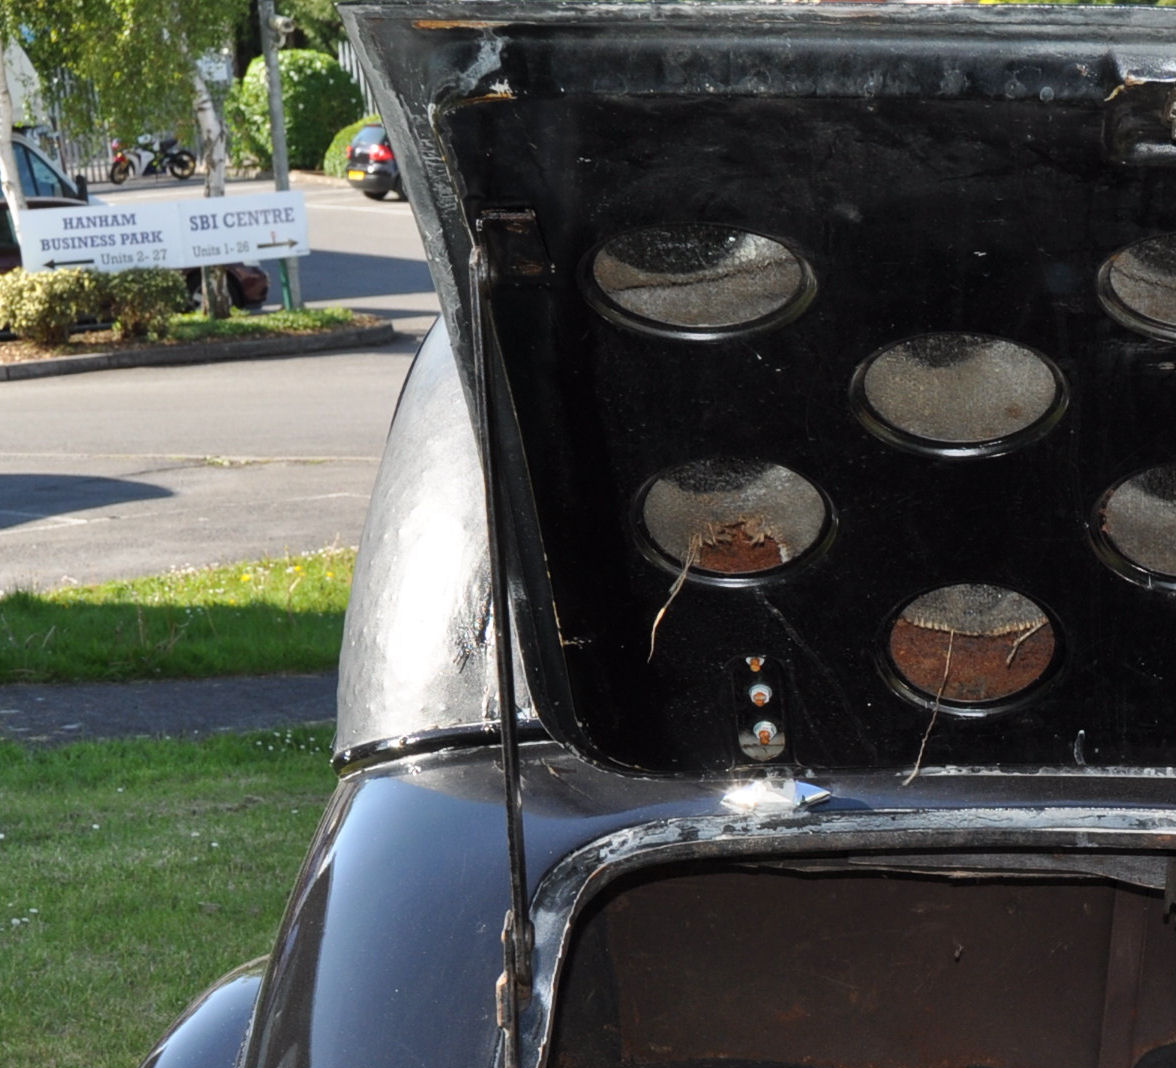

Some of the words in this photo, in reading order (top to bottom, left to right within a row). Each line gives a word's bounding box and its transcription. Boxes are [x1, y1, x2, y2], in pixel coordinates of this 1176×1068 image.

[62, 213, 137, 230] HANHAM
[189, 213, 218, 231] SBI
[222, 206, 295, 228] CENTRE
[40, 234, 116, 251] BUSINESS
[120, 230, 163, 246] PARK
[100, 252, 133, 266] Units
[192, 244, 221, 258] Units
